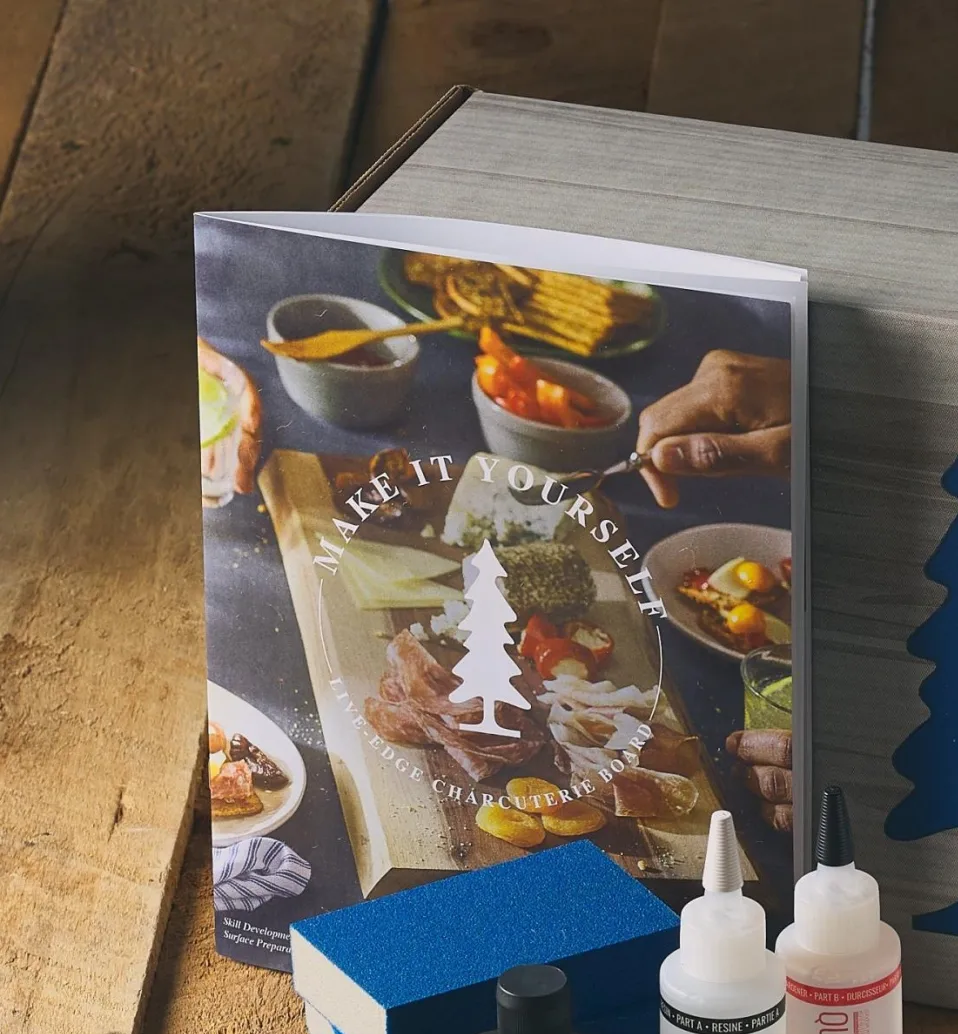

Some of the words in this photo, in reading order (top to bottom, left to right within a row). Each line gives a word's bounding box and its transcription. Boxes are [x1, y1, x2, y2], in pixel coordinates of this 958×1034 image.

[313, 472, 399, 576] MAKE
[409, 455, 453, 488] IT
[475, 456, 668, 620] YOURSELF
[328, 677, 424, 782] LIVE-EDGE
[432, 778, 597, 811] CHARCUTERIE
[598, 722, 654, 785] BOARD
[222, 917, 242, 929] Skill
[243, 922, 291, 941] Developme
[223, 930, 254, 944] Surface
[814, 992, 832, 1002] PART
[676, 1014, 694, 1029] PART
[697, 1022, 703, 1031] A
[711, 1022, 743, 1033] RESINE
[751, 1010, 775, 1029] PARTIE
